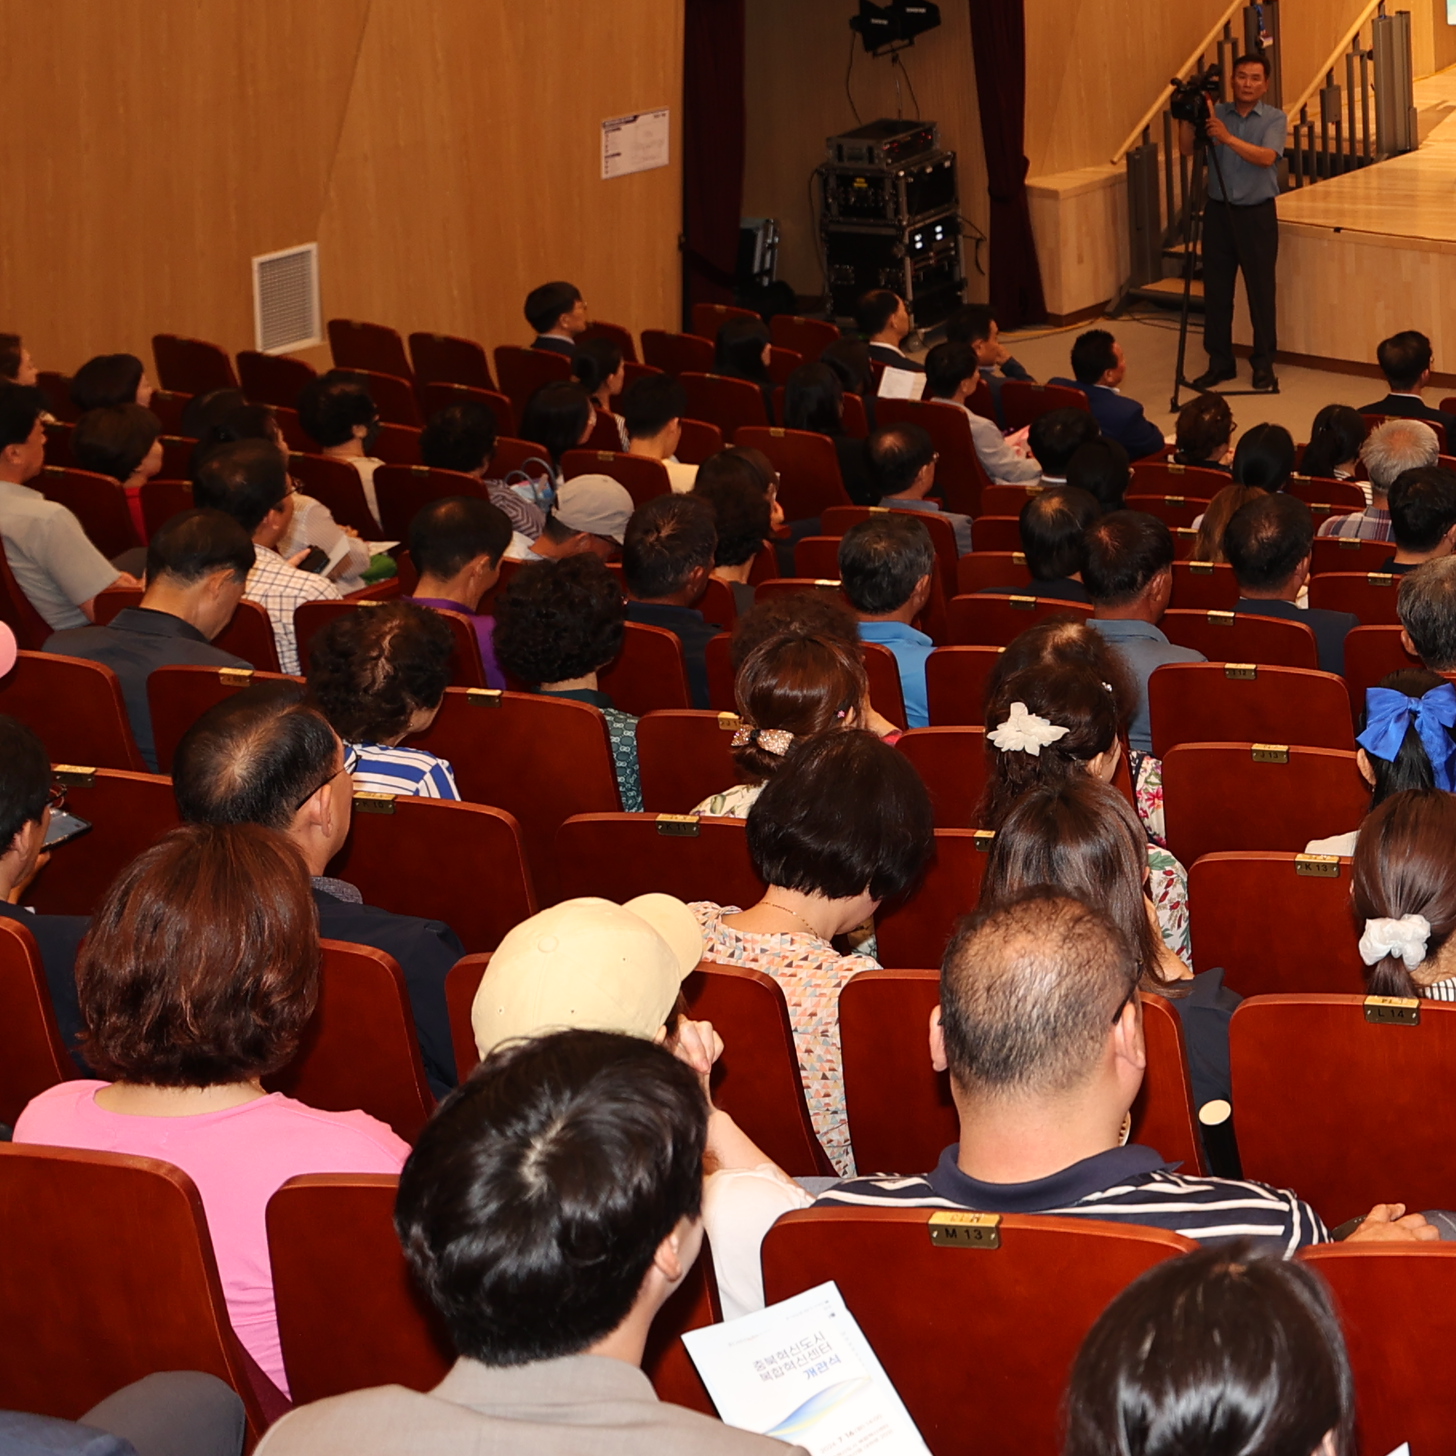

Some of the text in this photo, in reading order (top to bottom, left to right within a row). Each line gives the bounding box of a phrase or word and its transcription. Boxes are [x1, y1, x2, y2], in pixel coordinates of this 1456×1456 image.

[1316, 864, 1328, 872] 13
[1377, 1009, 1405, 1018] L 14
[944, 1227, 983, 1241] M 13
[753, 1331, 826, 1372] 충북혁신도시
[760, 1342, 833, 1383] 복합혁신센터
[803, 1354, 842, 1381] 개관식
